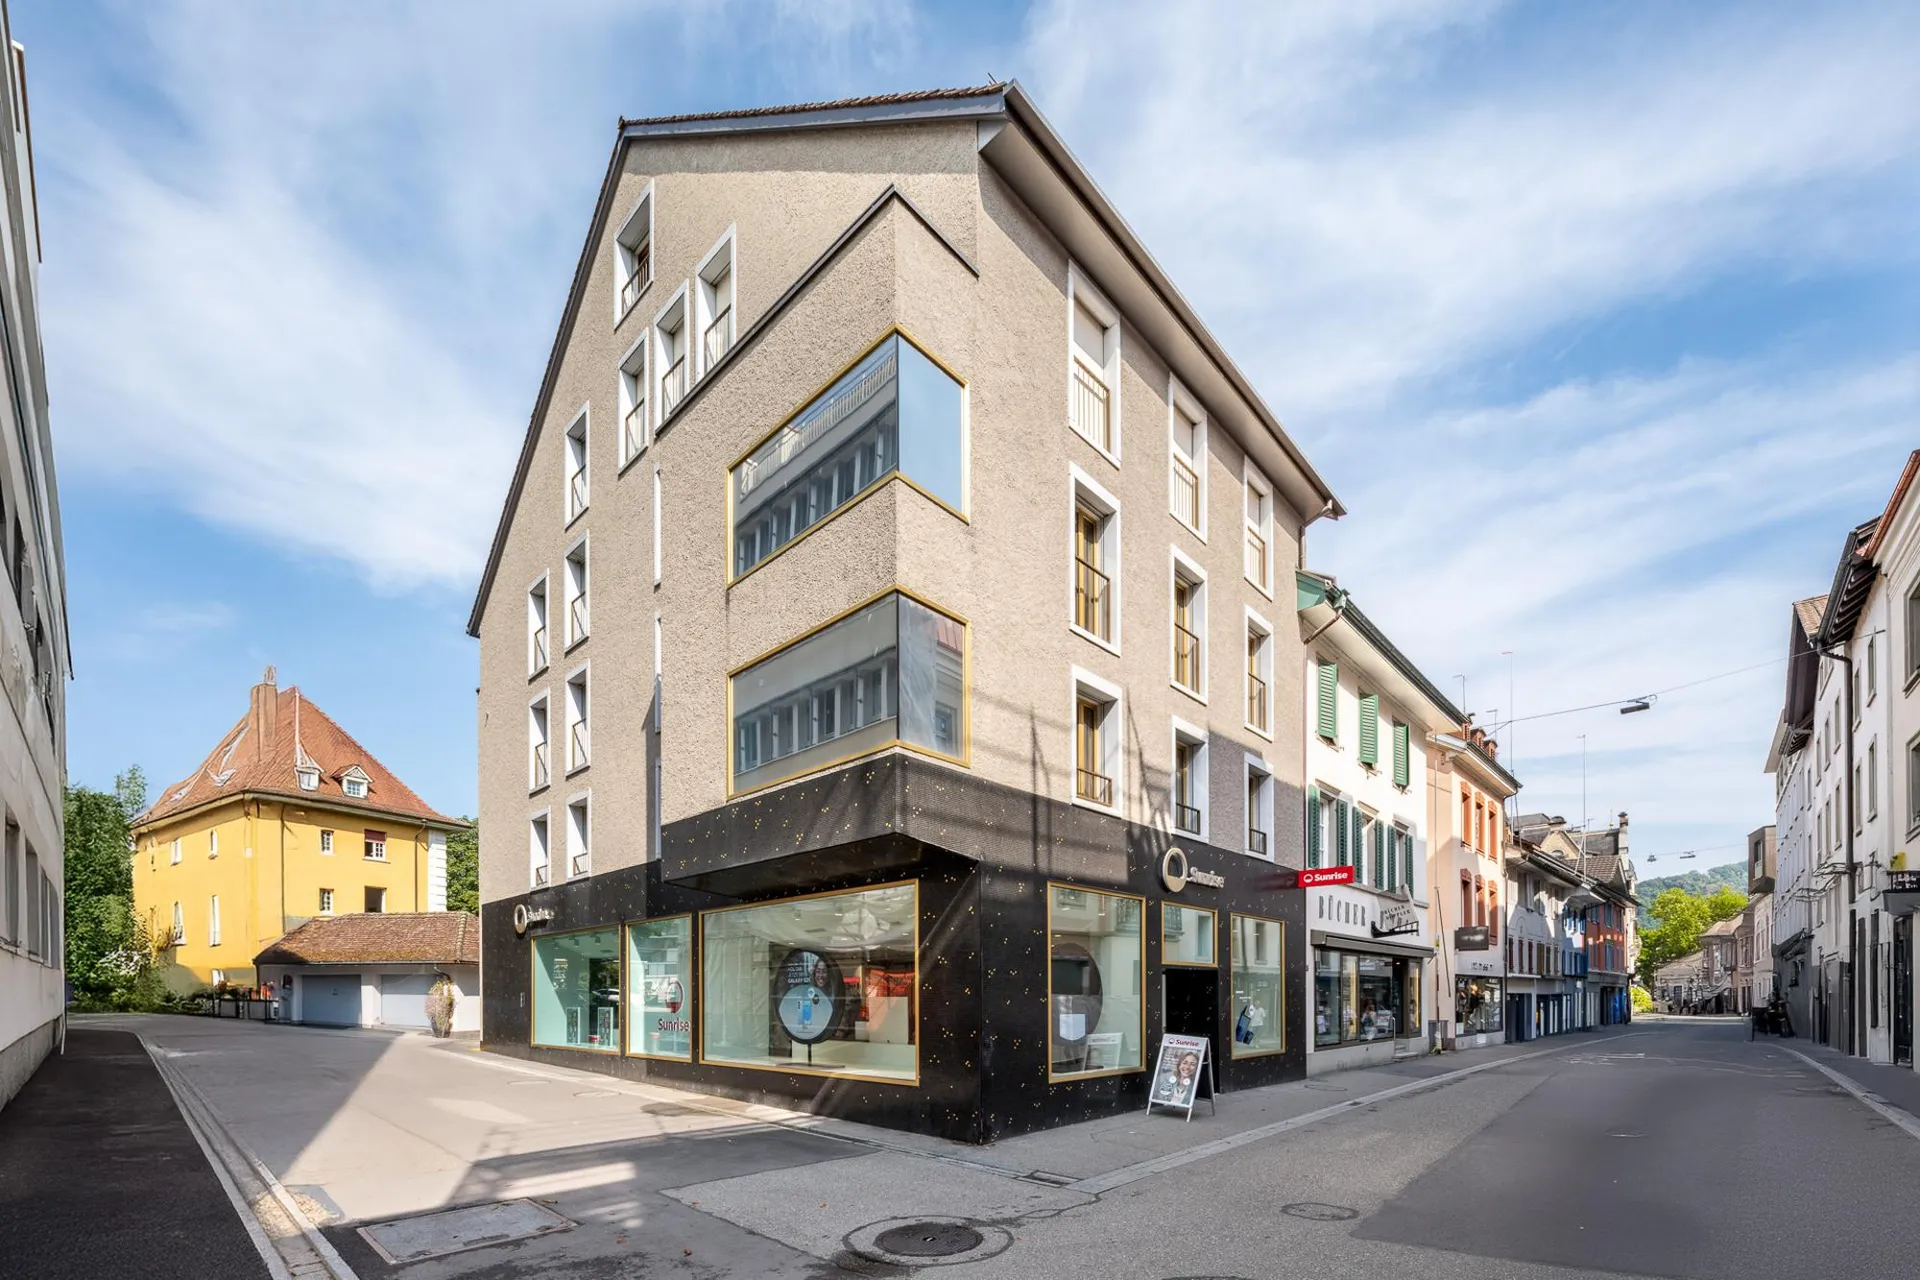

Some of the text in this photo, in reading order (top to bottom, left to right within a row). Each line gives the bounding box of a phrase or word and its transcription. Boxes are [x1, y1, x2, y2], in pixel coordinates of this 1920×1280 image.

[1190, 866, 1224, 888] Sunrise
[1314, 871, 1348, 882] Sunrise
[1319, 895, 1366, 926] BÜCHER
[657, 1017, 691, 1032] Sunrise
[1175, 1039, 1199, 1047] Sunrise
